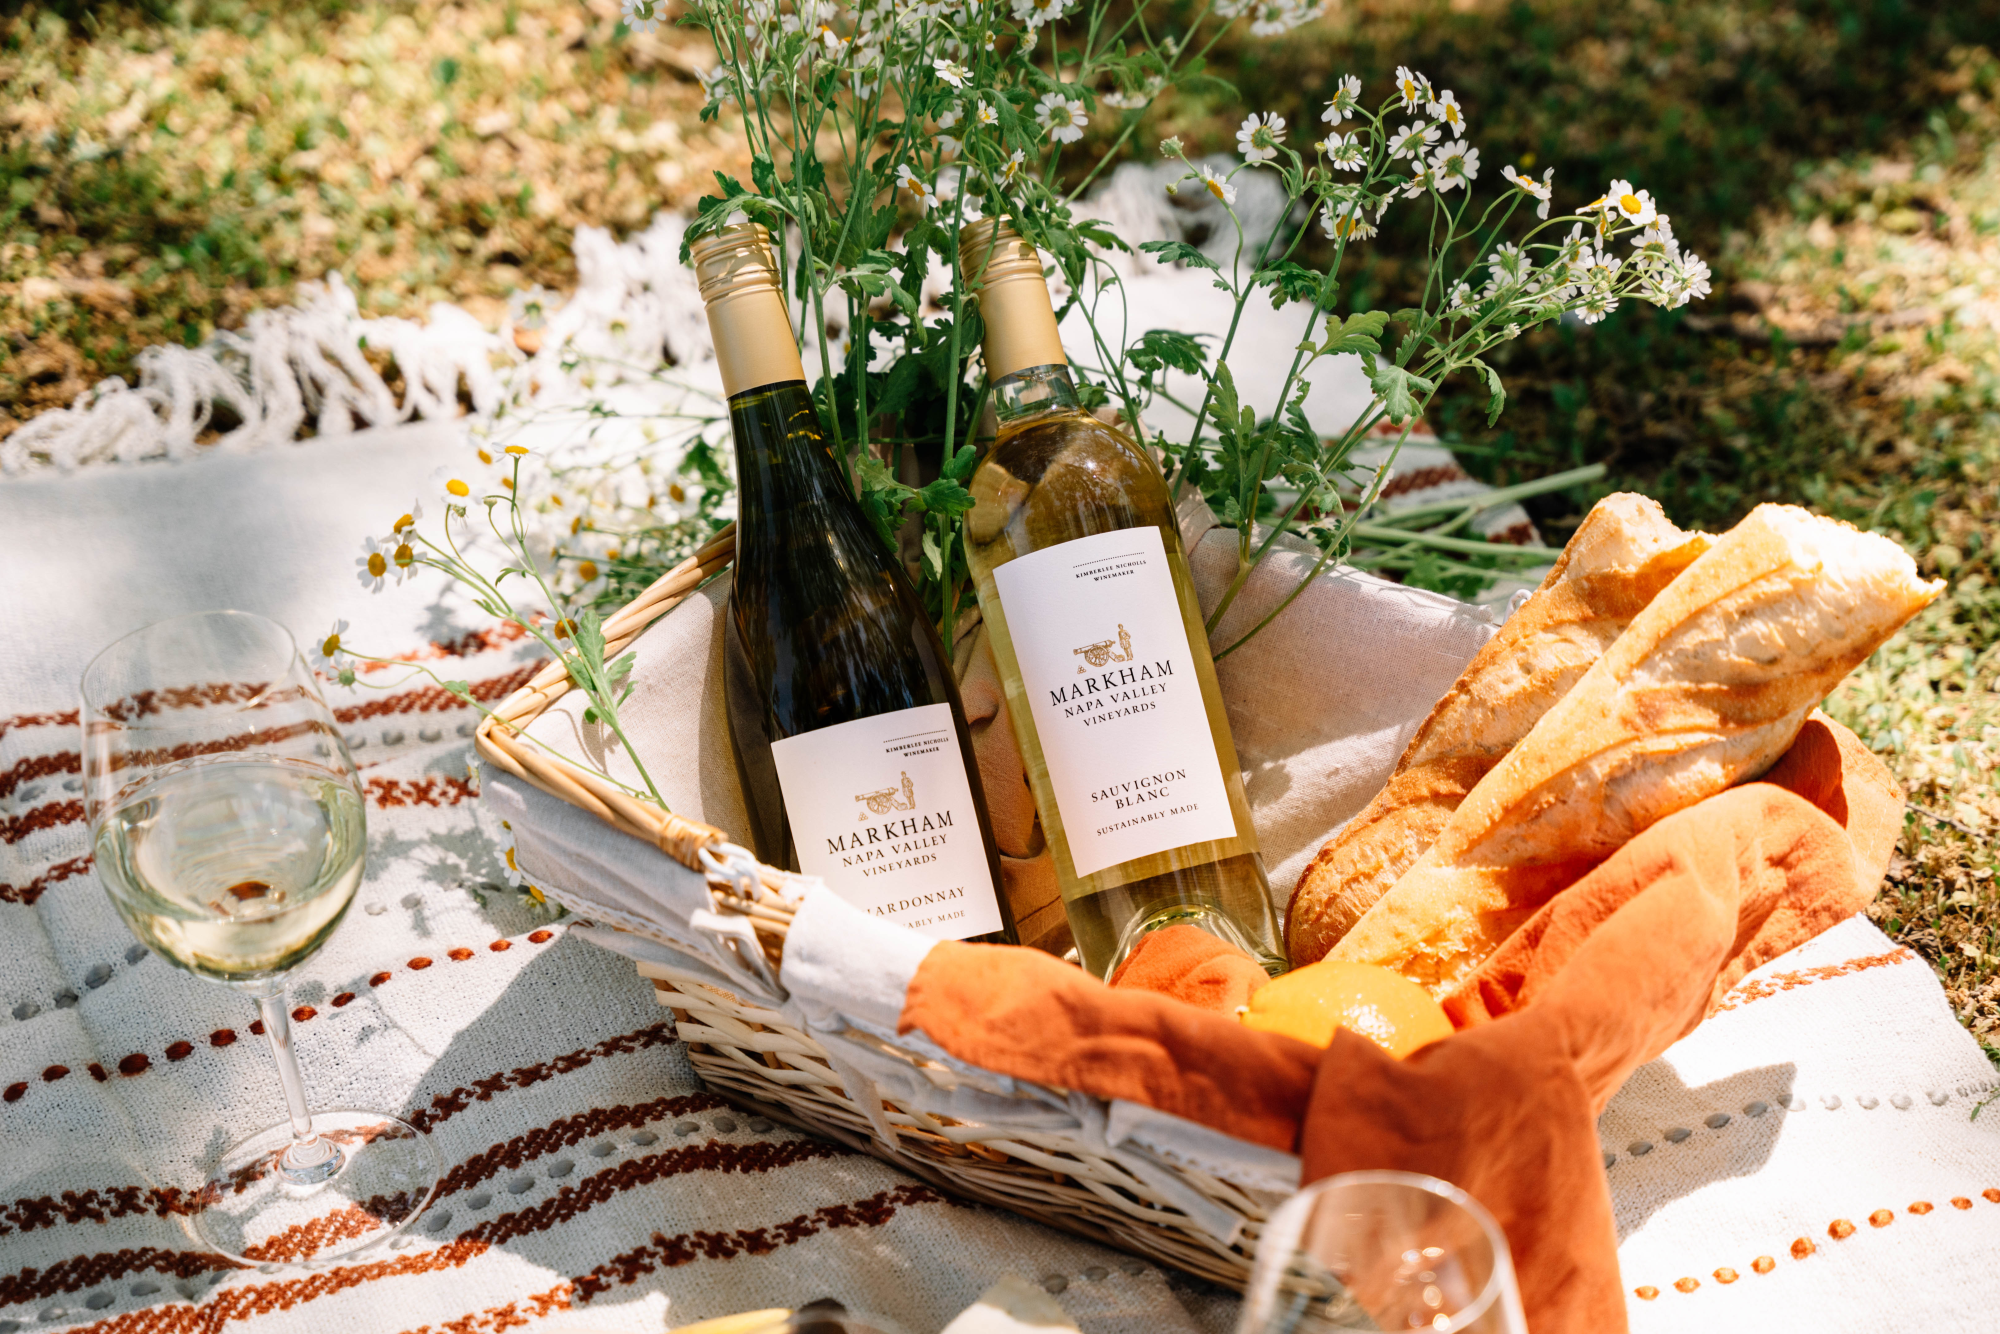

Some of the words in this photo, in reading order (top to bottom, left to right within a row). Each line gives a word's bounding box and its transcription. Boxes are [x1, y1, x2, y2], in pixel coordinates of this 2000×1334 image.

[1075, 565, 1114, 579] KIMBERLEE
[1115, 559, 1147, 569] NICHOLLS
[1093, 569, 1134, 582] WINEMAKER
[1049, 659, 1174, 707] MARKHAM
[1064, 698, 1104, 718] NAPA
[1110, 682, 1167, 704] VALLEY
[1083, 701, 1156, 727] VINEYARDS
[885, 741, 922, 753] KIMBERLEE
[923, 737, 949, 746] NICHOLLS
[903, 746, 940, 757] WINEMAKER
[1091, 768, 1187, 803] SAUVIGNON
[1115, 786, 1170, 810] BLANC
[826, 810, 954, 855] MARKHAM
[1096, 810, 1166, 837] SUSTAINABLY
[1169, 802, 1200, 816] MADE
[842, 848, 885, 868] NAPA
[891, 833, 948, 855] VALLEY
[862, 852, 938, 878] VINEYARDS
[861, 886, 965, 917] ARDONNAY
[937, 909, 966, 923] MADE
